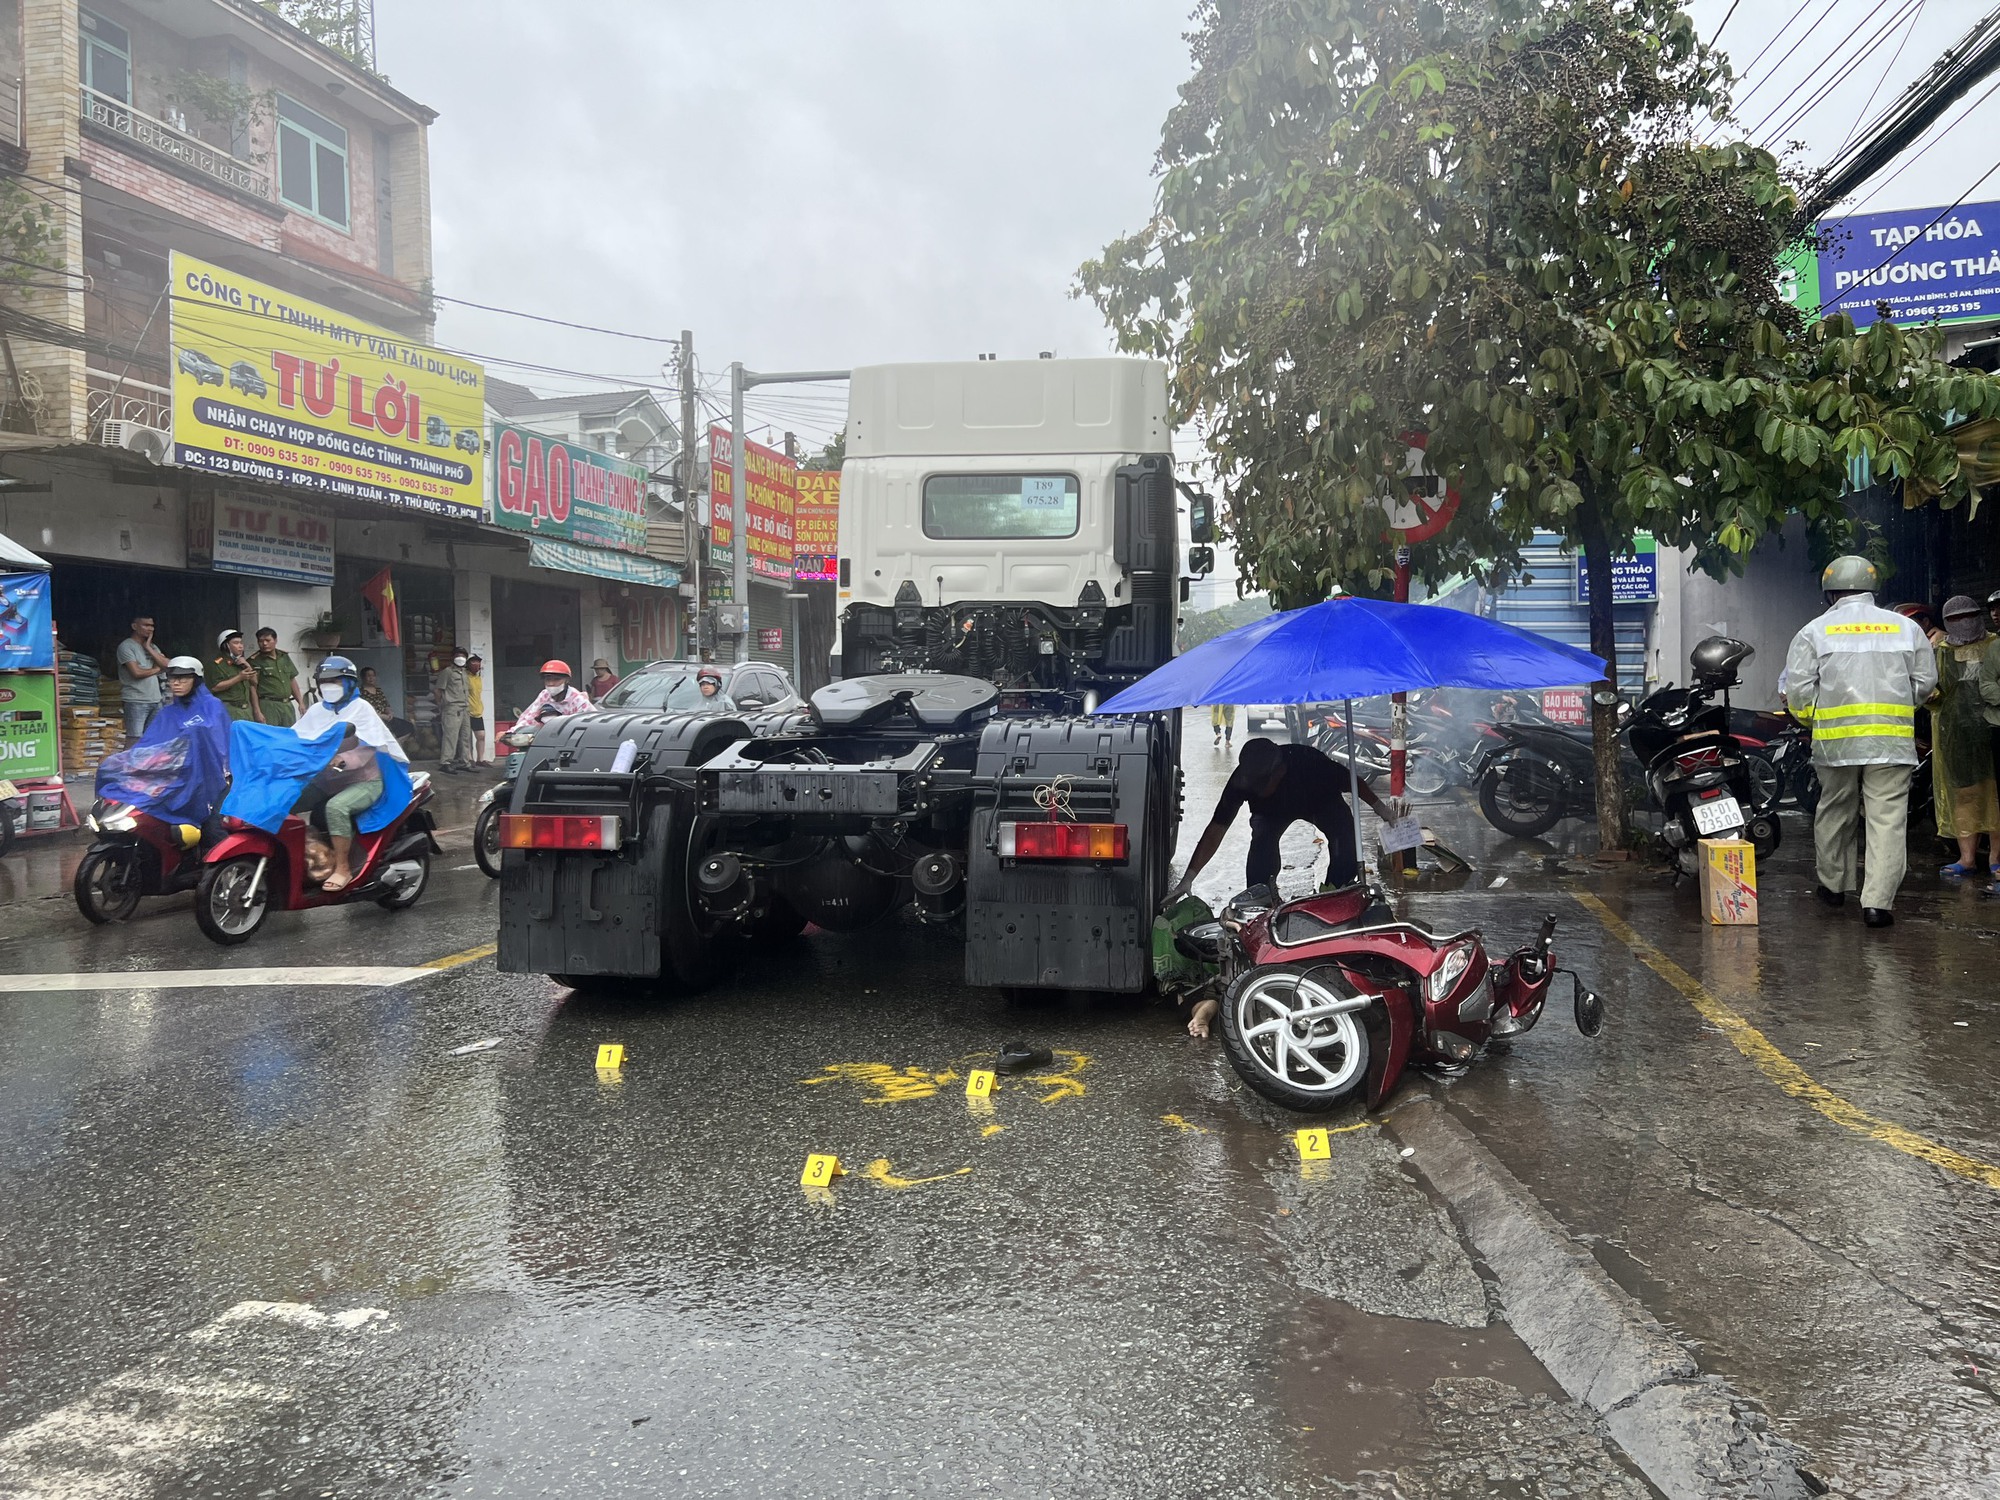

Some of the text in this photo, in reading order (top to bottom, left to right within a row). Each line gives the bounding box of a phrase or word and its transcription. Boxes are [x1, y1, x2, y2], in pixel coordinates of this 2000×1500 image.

[1925, 216, 1983, 242] HÓA
[1836, 261, 1947, 290] PHƯƠNG
[1914, 294, 1926, 302] AN
[1906, 306, 1935, 317] 0966
[1938, 304, 1959, 314] 226
[1960, 302, 1980, 312] 195
[186, 272, 242, 307] CÔNG
[248, 294, 271, 315] TY
[277, 304, 324, 335] TNHH
[330, 322, 362, 348] MTV
[428, 358, 445, 376] DU
[450, 369, 477, 388] LỊCH
[272, 350, 421, 443] TƯ LỜI
[207, 406, 464, 480] NHẬN CHẠY HỢP ĐỒNG CÁC TỈNH THÀNH PHỐ
[224, 436, 454, 496] ĐT: 0909 635 387 0909 635 795 0903 635 387
[184, 450, 206, 465] ĐC:
[209, 456, 230, 470] 123
[232, 460, 274, 479] ĐƯỜNG
[276, 470, 284, 480] 5
[292, 472, 312, 486] KP2
[320, 478, 330, 490] P.
[332, 481, 354, 495] LINH
[357, 485, 382, 500] XUÂN
[389, 493, 402, 504] TP.
[405, 496, 422, 508] THỦ
[424, 498, 441, 512] ĐỨC
[460, 508, 478, 520] HCM
[498, 429, 570, 529] GẠO
[572, 454, 606, 506] THÀNH
[640, 480, 647, 517] 2
[714, 470, 730, 494] TEM
[796, 472, 840, 490] DÁN
[1034, 481, 1053, 490] T89
[798, 490, 840, 504] XE
[1027, 496, 1059, 505] 675.28
[752, 514, 762, 531] XE
[714, 526, 730, 544] THAY
[795, 544, 816, 553] BỌC
[1625, 564, 1652, 574] THẢO
[1700, 802, 1732, 818] 61-01
[1700, 812, 1740, 832] 735.09
[606, 1050, 612, 1062] 1
[976, 1076, 984, 1090] 6
[1308, 1135, 1319, 1152] 2
[813, 1161, 824, 1178] 3
